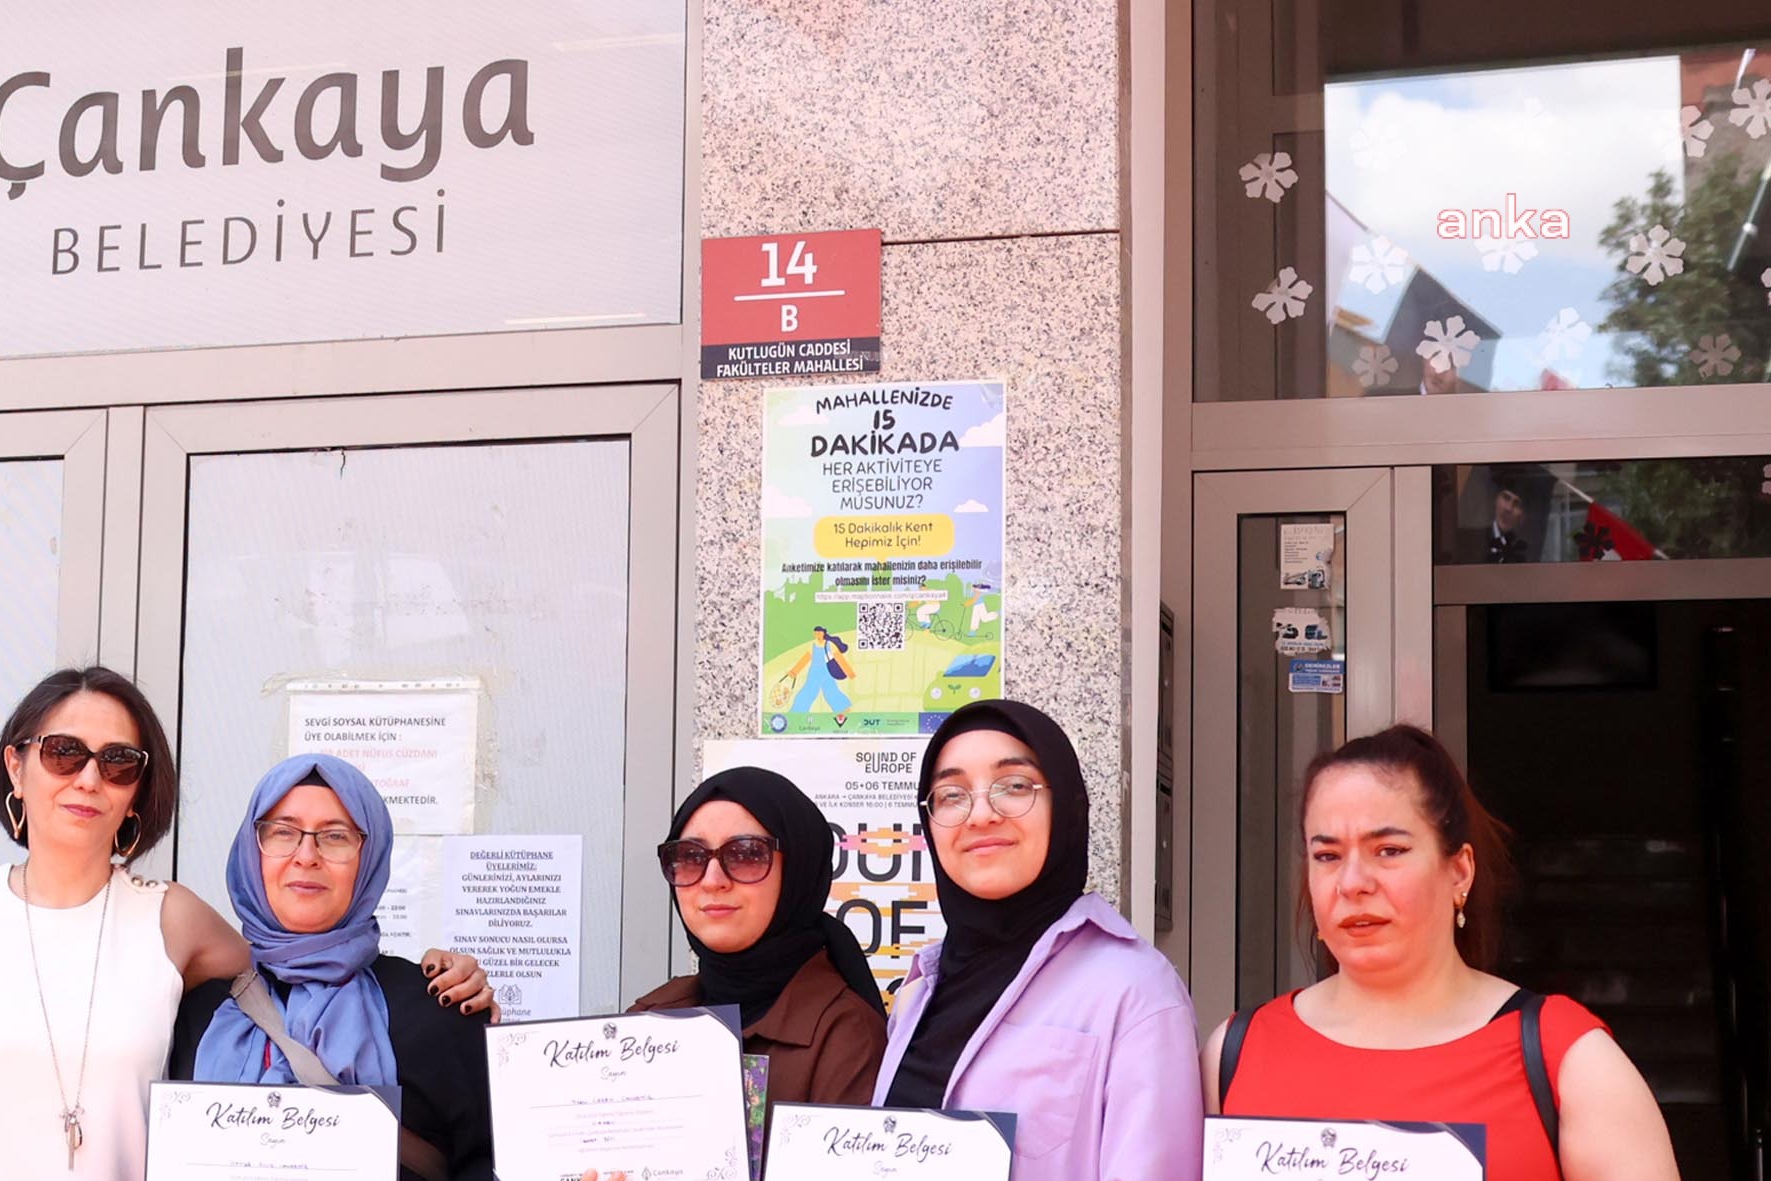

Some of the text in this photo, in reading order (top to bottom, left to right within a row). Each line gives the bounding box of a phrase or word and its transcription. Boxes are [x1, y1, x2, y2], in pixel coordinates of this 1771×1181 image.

[50, 188, 447, 275] BELEDİYESİ
[760, 240, 818, 287] 14
[781, 304, 798, 332] B
[728, 338, 851, 361] KUTLUGÜN CADDESİ
[716, 355, 864, 378] FAKÜLTELER MAHALLESİ
[816, 387, 953, 414] MAHALLENİZDE
[873, 409, 896, 431] 15
[810, 430, 960, 458] DAKİKADA
[823, 457, 943, 476] HER AKTİVİTEYE
[832, 476, 933, 496] ERİŞEBİLİYOR
[833, 521, 933, 534] 15 Dakikalık Kent
[845, 534, 921, 550] Hepimiz İçin!
[781, 562, 825, 574] Anketimize
[864, 560, 916, 572] mahallenizin
[918, 560, 938, 570] daha
[892, 575, 927, 586] misiniz?
[304, 716, 447, 727] SEVGİ SOYSAL KÜTÜPHANESİNE
[304, 732, 321, 741] ÜYE
[324, 731, 376, 741] OLABİLMEK
[377, 731, 397, 743] İÇİN
[855, 752, 917, 763] SOUND OF
[864, 762, 913, 774] EUROPE
[374, 777, 412, 788] TOĞRAF
[882, 781, 920, 791] TEMMU
[382, 795, 439, 805] KMEKTEDİR.
[470, 850, 554, 860] DEĞERLİ KÜTÜPHANE
[515, 874, 562, 882] AYLARINIZI
[499, 884, 527, 894] YOĞUN
[476, 895, 547, 905] HAZIRLANDIĞINIZ
[455, 908, 567, 918] SINAVLARINIZDA BAŞARILAR
[488, 918, 533, 928] DİLİYORUZ.
[835, 899, 928, 959] OF
[453, 935, 568, 944] SINAV SONUCU NASIL OLURSA
[476, 946, 506, 955] SAĞLIK
[506, 947, 518, 955] VE
[518, 947, 572, 956] MUTLULUKLA
[482, 957, 560, 967] GÜZEL BİR GELECEK
[486, 970, 542, 978] ZLERLE OLSUN
[501, 1007, 531, 1016] üphane
[543, 1036, 681, 1068] Katılım Belgesi
[205, 1101, 341, 1134] Katılım Belgesi
[823, 1125, 952, 1163] Katılım Belgesi
[1255, 1140, 1409, 1181] Katılım Belgesi
